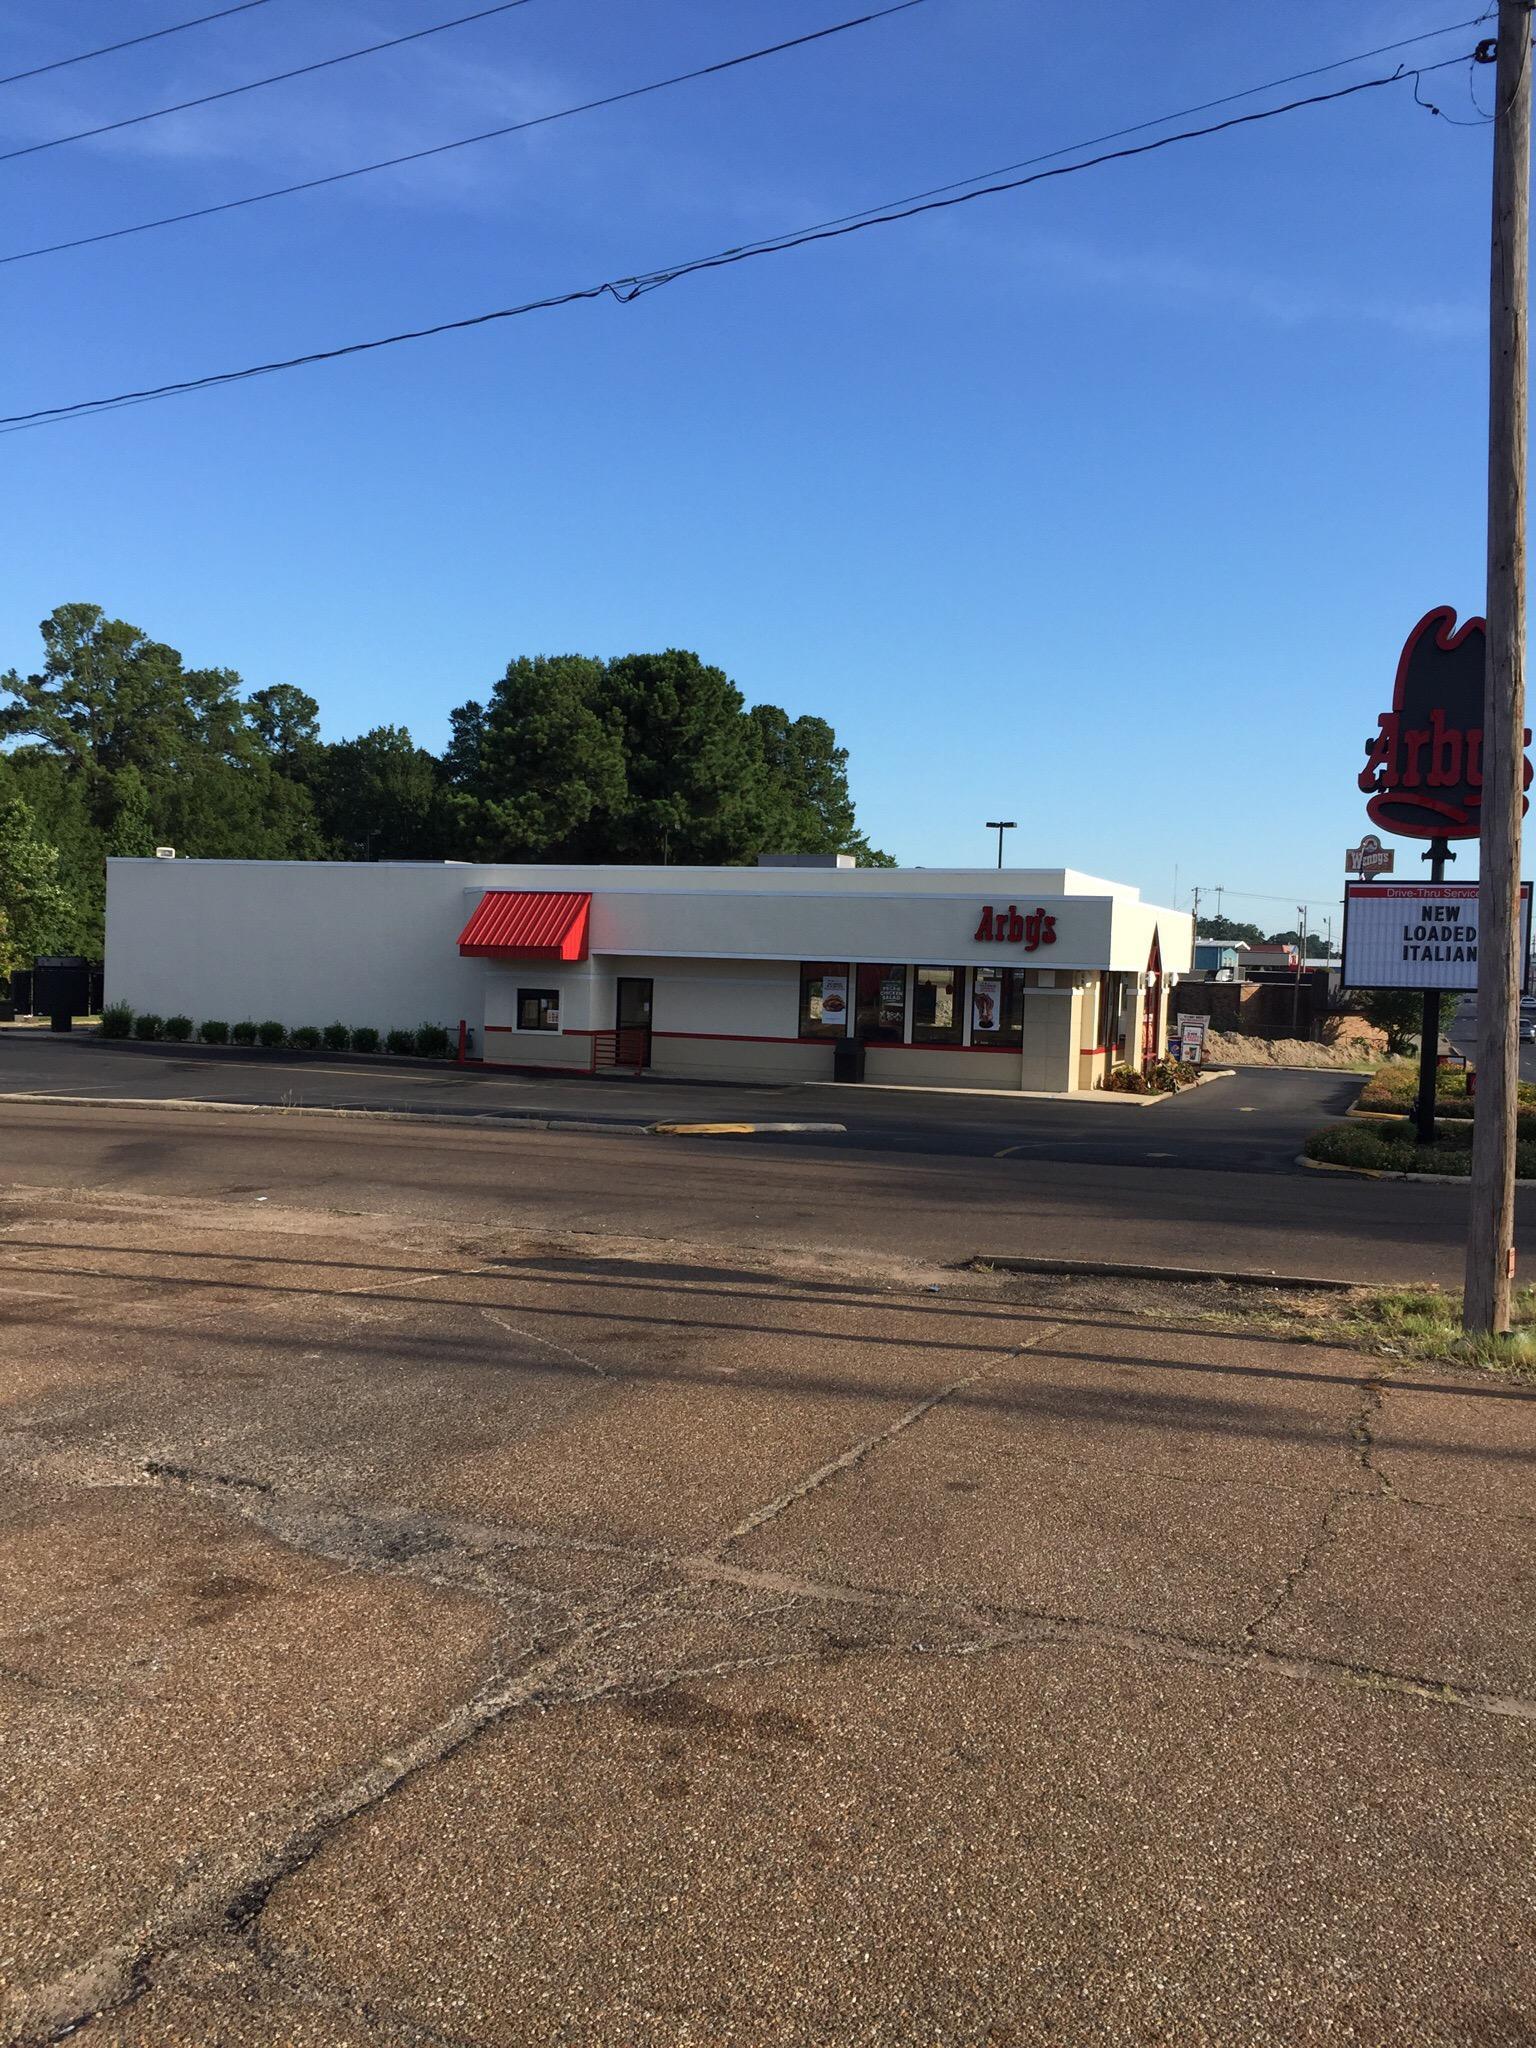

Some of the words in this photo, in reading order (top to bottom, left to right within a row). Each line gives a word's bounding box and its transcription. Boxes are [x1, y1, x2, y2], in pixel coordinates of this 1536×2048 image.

[1387, 888, 1441, 897] Drive-Thru
[1421, 905, 1460, 922] NEW
[974, 905, 1057, 952] Arby's
[1403, 925, 1477, 942] LOADED
[1402, 945, 1478, 962] ITALIAN
